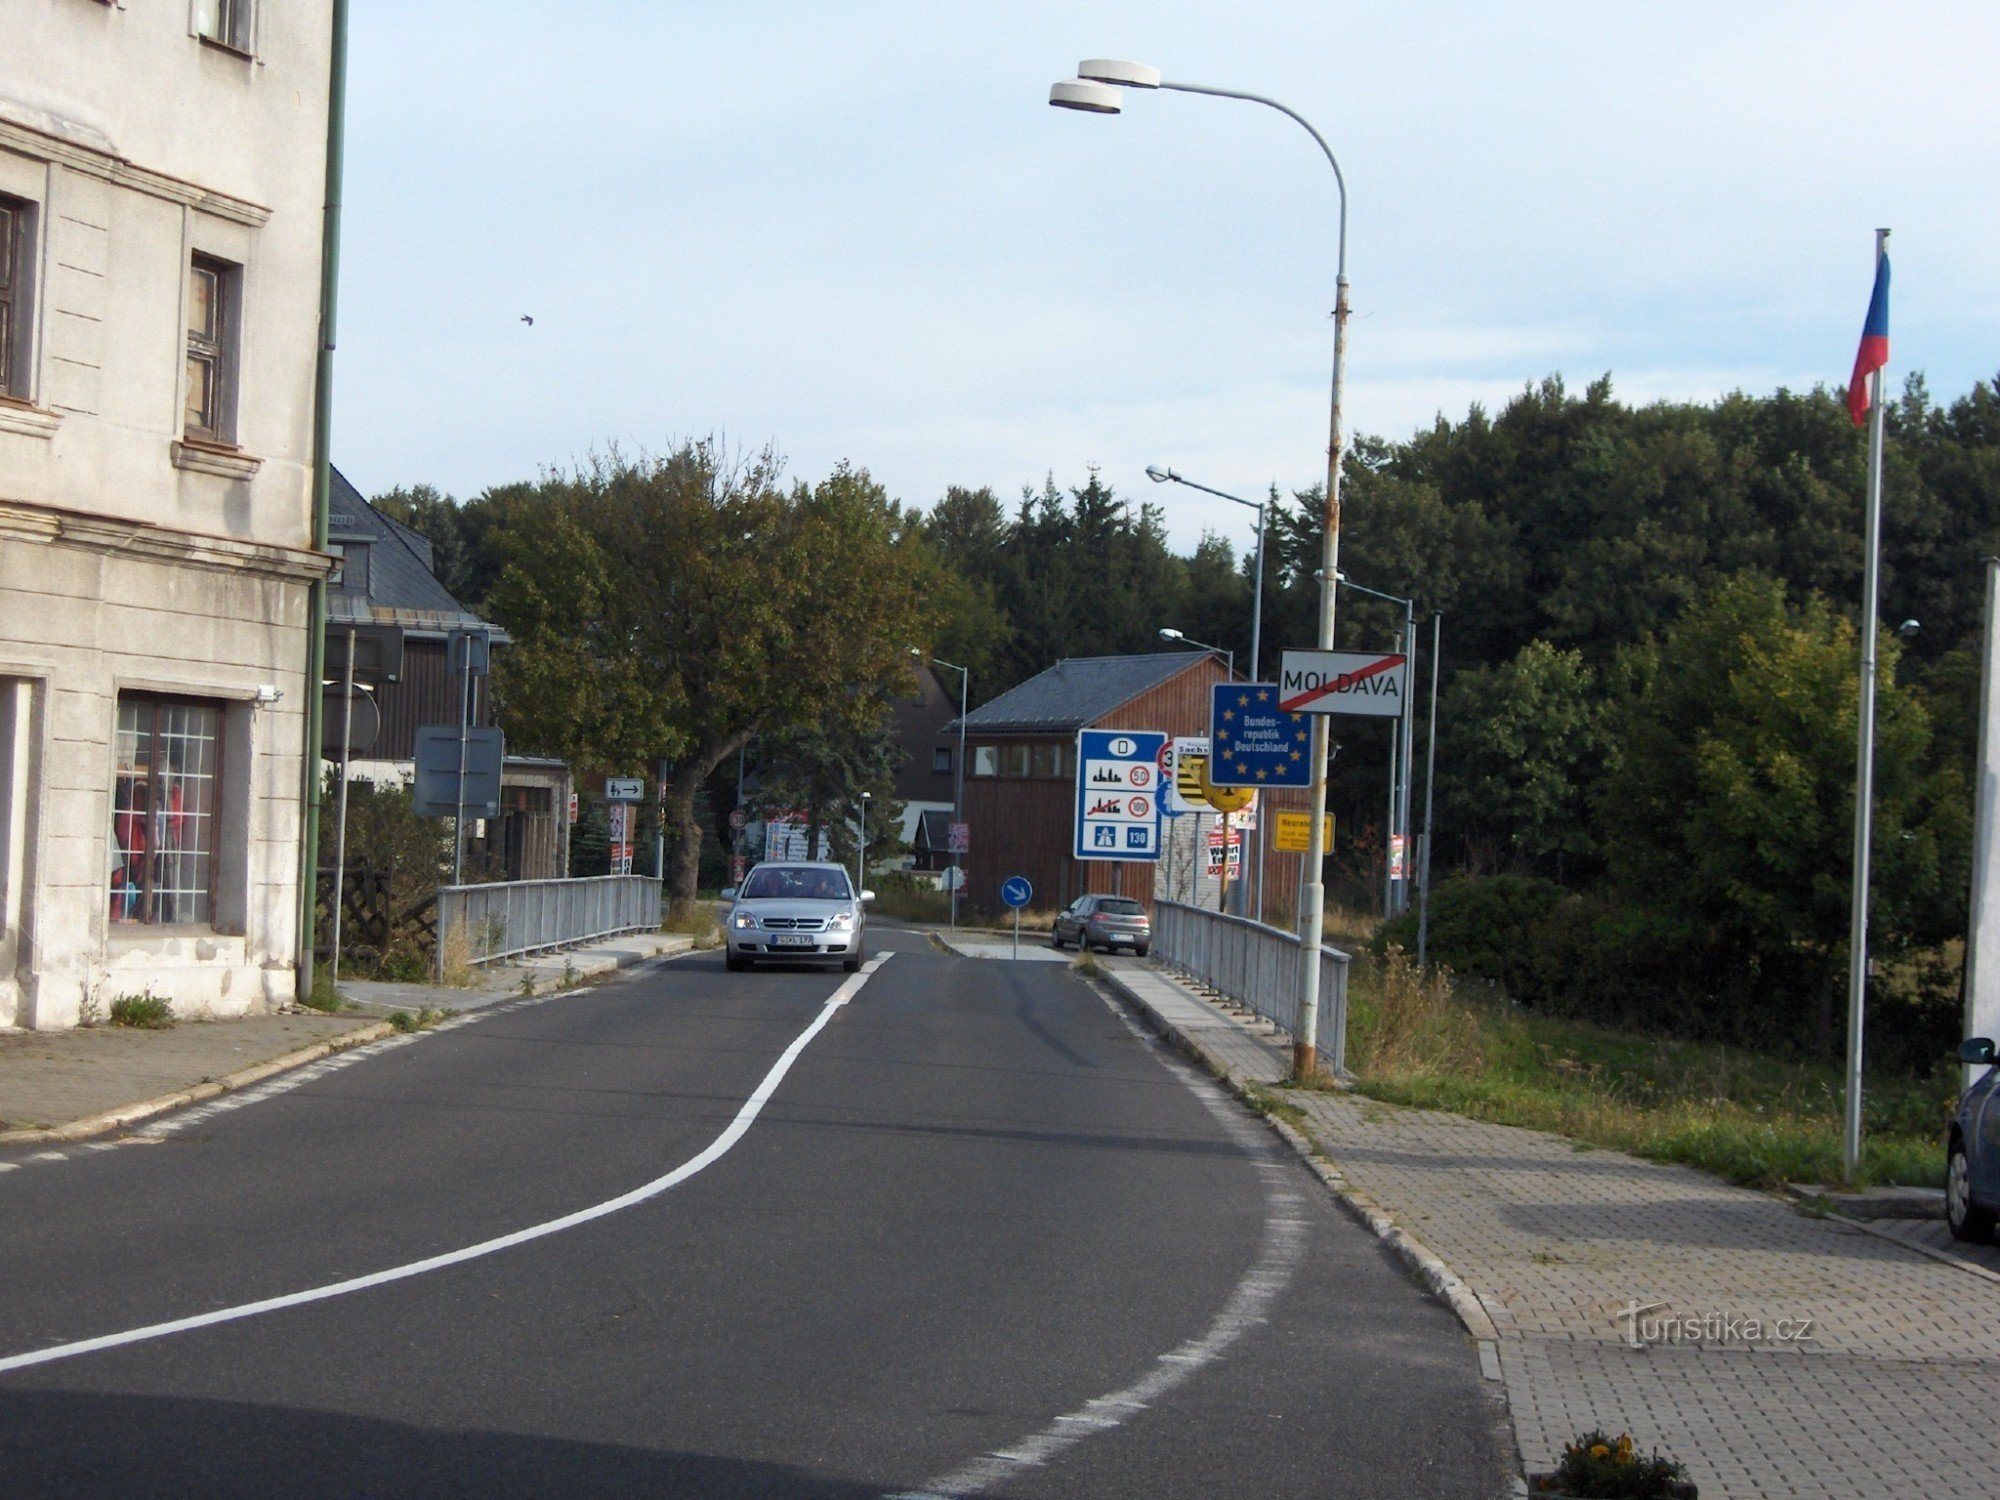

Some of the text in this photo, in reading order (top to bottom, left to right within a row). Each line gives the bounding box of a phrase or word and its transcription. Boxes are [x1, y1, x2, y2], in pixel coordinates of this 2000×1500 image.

[1284, 670, 1399, 697] MOLDAVA
[1244, 715, 1282, 727] Bundes-
[1243, 729, 1280, 741] republik
[1118, 740, 1129, 754] D
[1178, 746, 1209, 754] Sachs
[1234, 740, 1290, 753] Deutschland
[1133, 770, 1146, 782] 50
[1132, 802, 1145, 813] 100
[1129, 831, 1146, 844] 130
